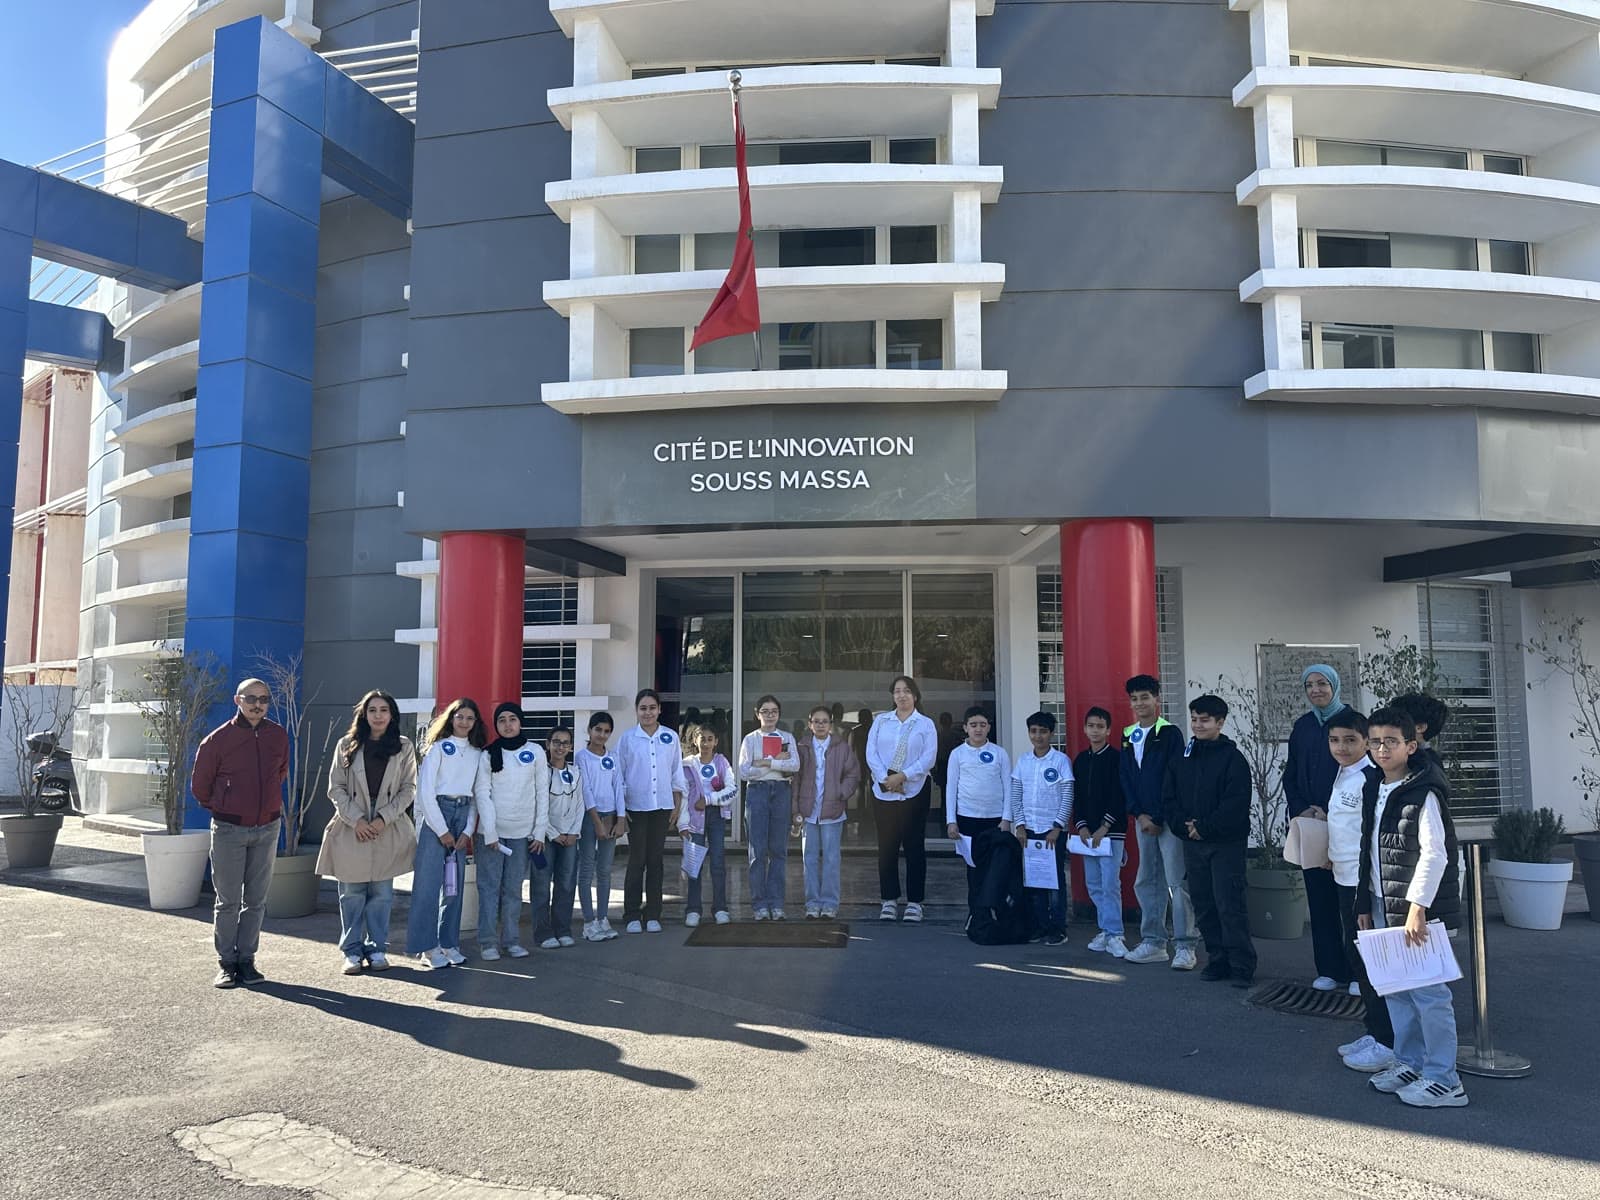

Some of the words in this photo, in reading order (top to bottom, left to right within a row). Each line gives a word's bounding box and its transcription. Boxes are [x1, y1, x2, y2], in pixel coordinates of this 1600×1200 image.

[653, 437, 706, 462] CITÉ
[711, 441, 744, 460] DE
[748, 436, 914, 459] L'INNOVATION
[690, 471, 773, 492] SOUSS
[780, 469, 871, 489] MASSA
